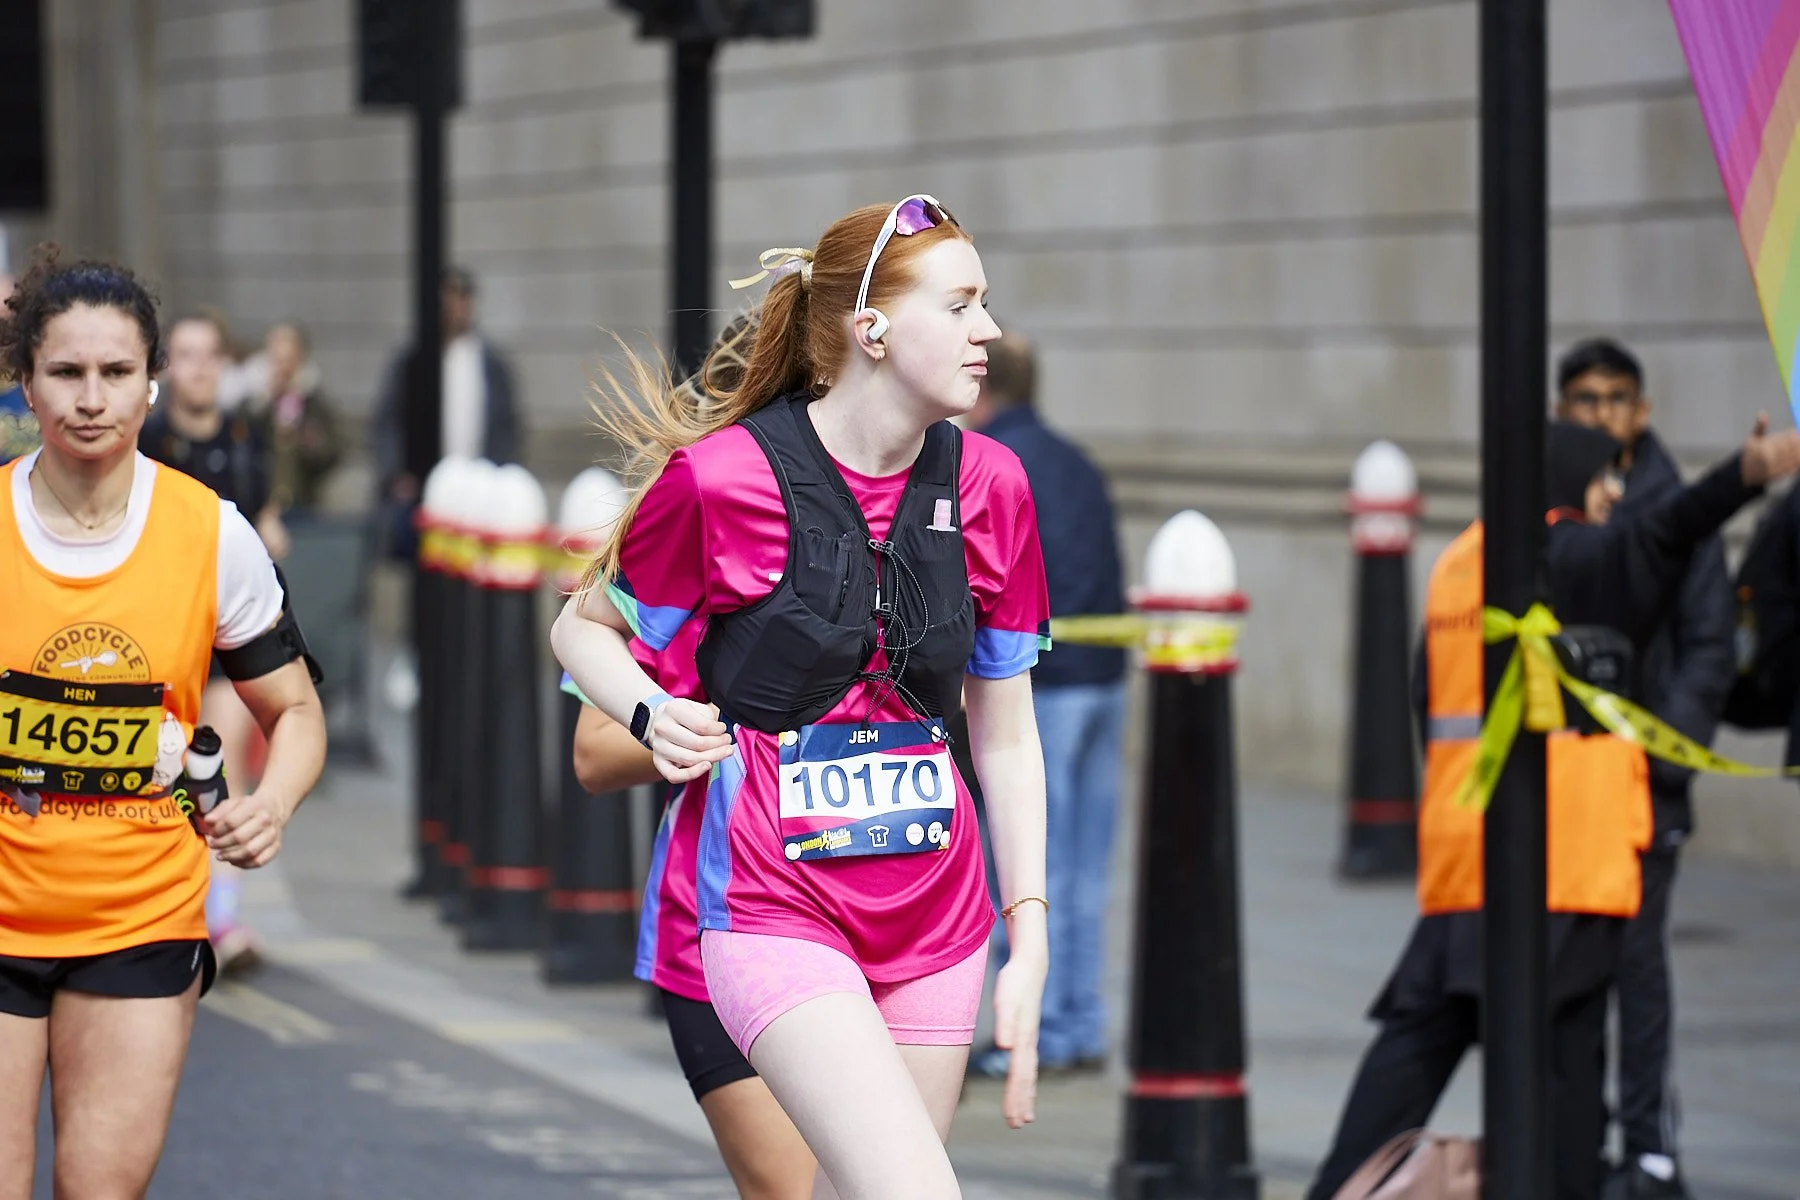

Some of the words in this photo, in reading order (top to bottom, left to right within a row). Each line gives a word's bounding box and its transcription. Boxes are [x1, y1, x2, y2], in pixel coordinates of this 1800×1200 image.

[37, 627, 144, 674] FOODCYCLE
[64, 687, 96, 701] HEN
[2, 706, 150, 756] 14657
[848, 729, 879, 744] JEM
[792, 759, 943, 810] 10170
